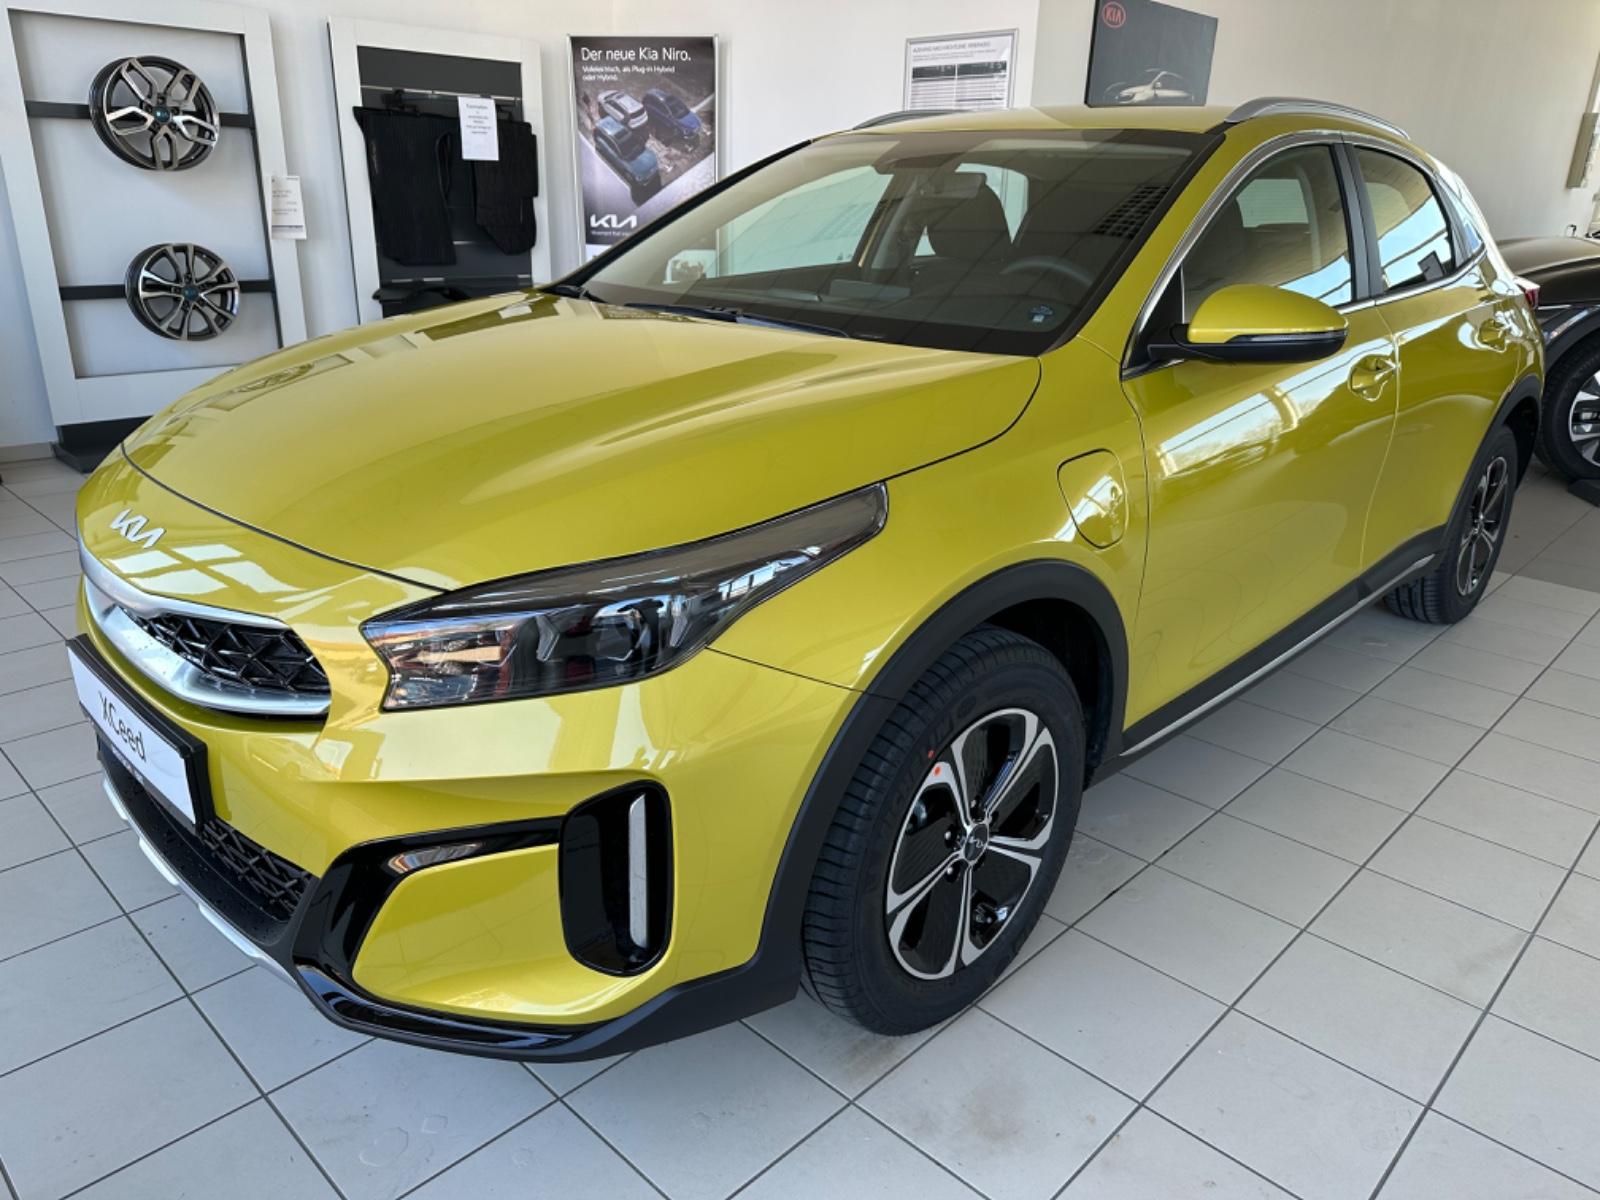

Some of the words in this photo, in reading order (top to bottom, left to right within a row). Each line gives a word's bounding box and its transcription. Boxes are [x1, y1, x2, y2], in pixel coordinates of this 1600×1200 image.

[1105, 7, 1122, 23] KIA
[581, 47, 603, 61] Der
[606, 49, 636, 61] neue
[639, 46, 659, 61] Kia
[662, 47, 692, 61] Niro.
[590, 213, 638, 229] KIA
[110, 507, 167, 549] KIA
[98, 690, 146, 763] XCeed
